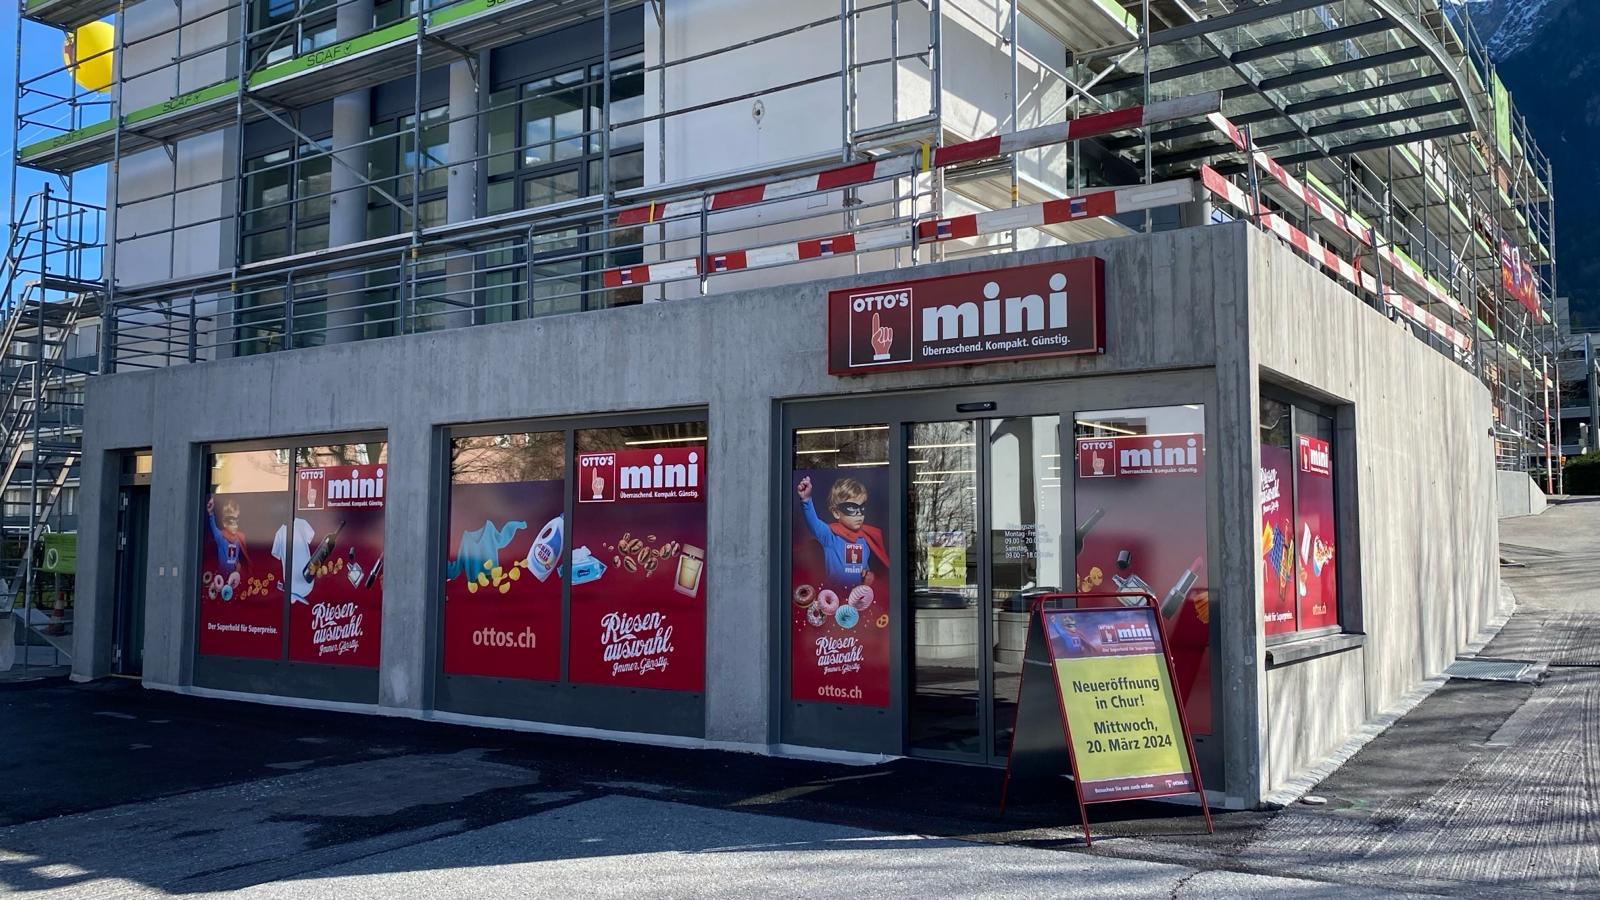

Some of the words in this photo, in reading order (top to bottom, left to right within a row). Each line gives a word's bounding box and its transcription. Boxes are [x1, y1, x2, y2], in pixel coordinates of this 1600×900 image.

[306, 46, 342, 67] SCAF
[853, 292, 908, 313] OTTO'S
[922, 272, 1068, 342] mini
[922, 341, 983, 356] Überraschend.
[985, 335, 1029, 350] Kompakt.
[1032, 333, 1071, 347] Günstig.
[1081, 441, 1113, 450] OTTO'S
[1120, 438, 1197, 467] mini
[1310, 443, 1329, 469] mini
[581, 456, 613, 467] OTTO'S
[620, 451, 698, 489] mini
[301, 471, 324, 480] OTTO'S
[327, 468, 384, 499] mini
[620, 491, 653, 499] Überraschend.
[654, 490, 677, 500] Kompakt.
[678, 489, 699, 498] Günstig.
[845, 565, 863, 573] mini
[311, 601, 358, 630] Riesen-
[207, 622, 216, 630] Der
[217, 623, 240, 632] Superheld
[248, 625, 278, 635] Superpreise.
[313, 613, 364, 644] auswahl.
[472, 626, 536, 648] ottos.ch
[601, 611, 666, 644] Riesen-
[1117, 623, 1152, 638] mini
[603, 626, 674, 662] auswahl.
[815, 635, 858, 656] Riesen-
[817, 645, 864, 666] auswahl.
[818, 684, 862, 699] ottos.ch
[1072, 677, 1160, 694] Neueröffnung
[1095, 696, 1108, 710] in
[1111, 694, 1145, 709] Chur!
[1094, 717, 1158, 735] Mittwoch,
[1086, 739, 1106, 754] 20.
[1108, 737, 1141, 752] März
[1142, 734, 1172, 749] 2024
